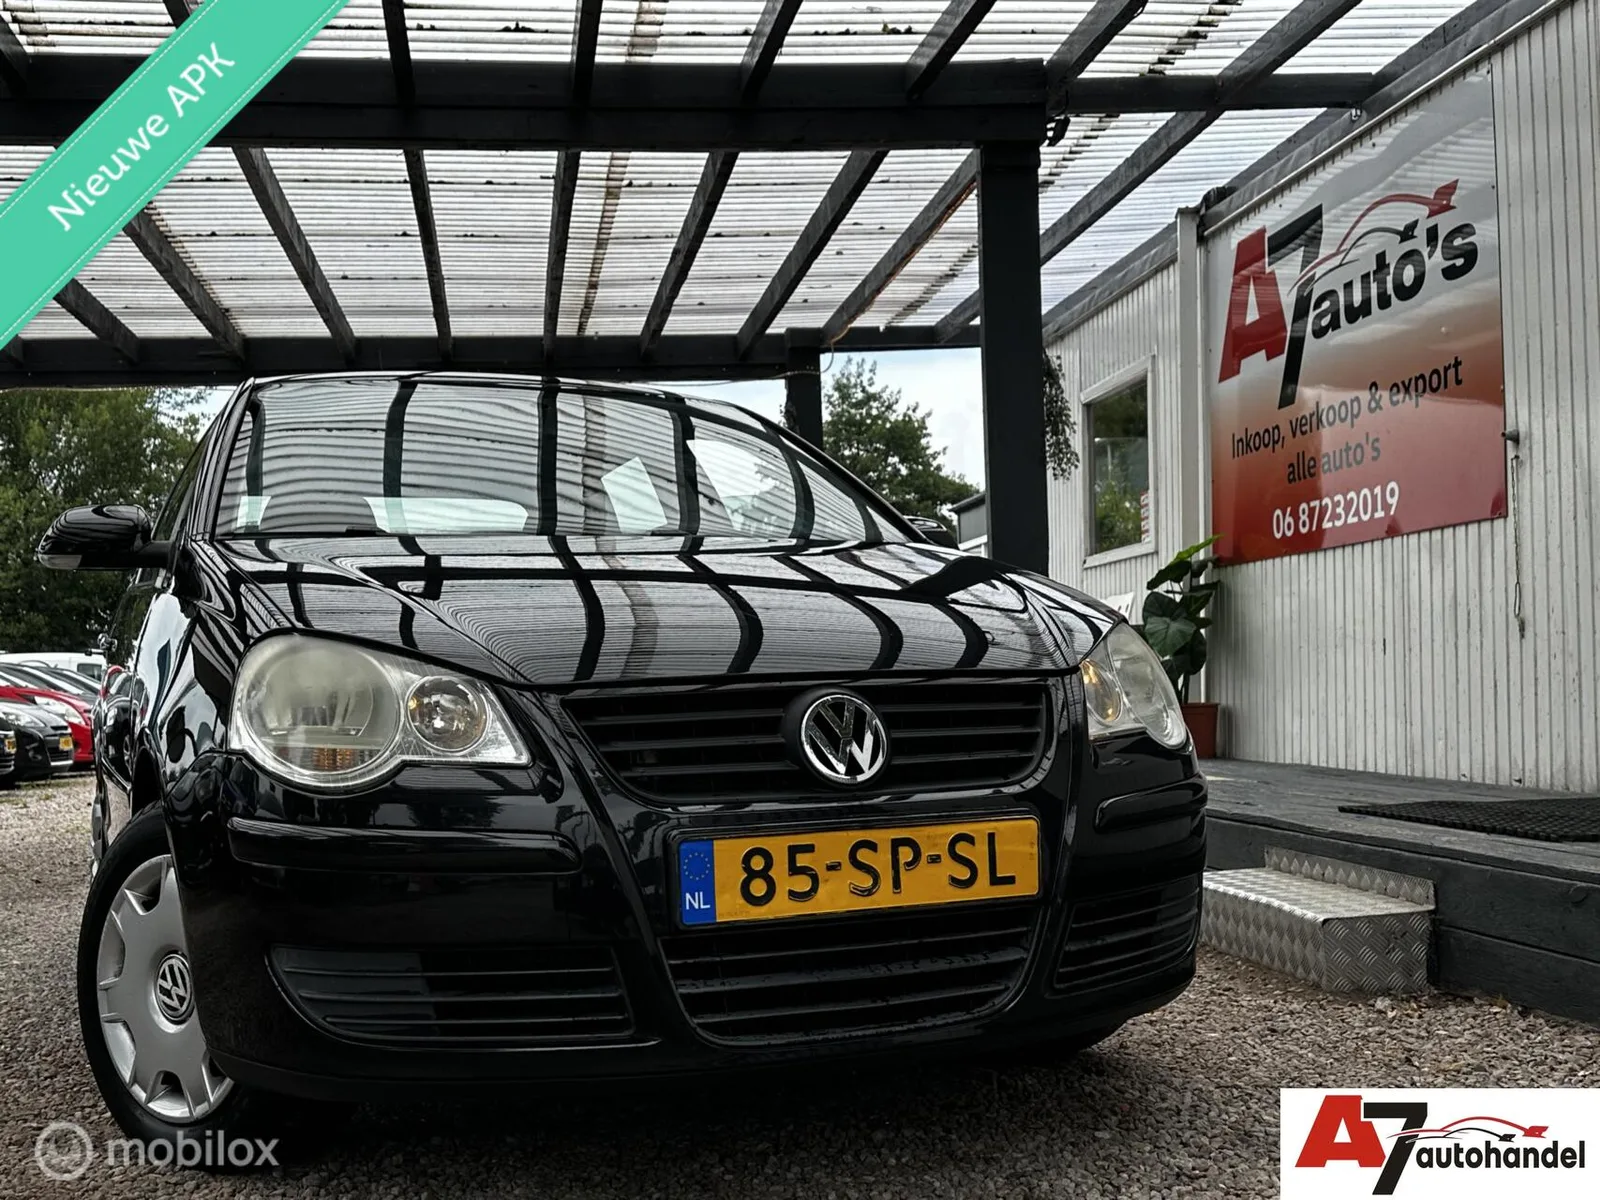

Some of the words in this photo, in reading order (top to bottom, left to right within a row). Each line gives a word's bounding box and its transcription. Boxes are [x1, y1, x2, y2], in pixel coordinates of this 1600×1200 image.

[1218, 203, 1323, 410] A7
[1311, 222, 1478, 339] auto's
[1232, 424, 1286, 459] Inkoop,
[1289, 396, 1362, 438] verkoop
[1368, 380, 1383, 414] &
[1389, 355, 1463, 409] export
[1287, 451, 1317, 485] alle
[1321, 432, 1381, 474] auto's
[1272, 506, 1295, 540] 06
[1298, 480, 1400, 535] 87232019
[684, 891, 711, 910] NL
[739, 832, 1017, 907] 85-SP-SL
